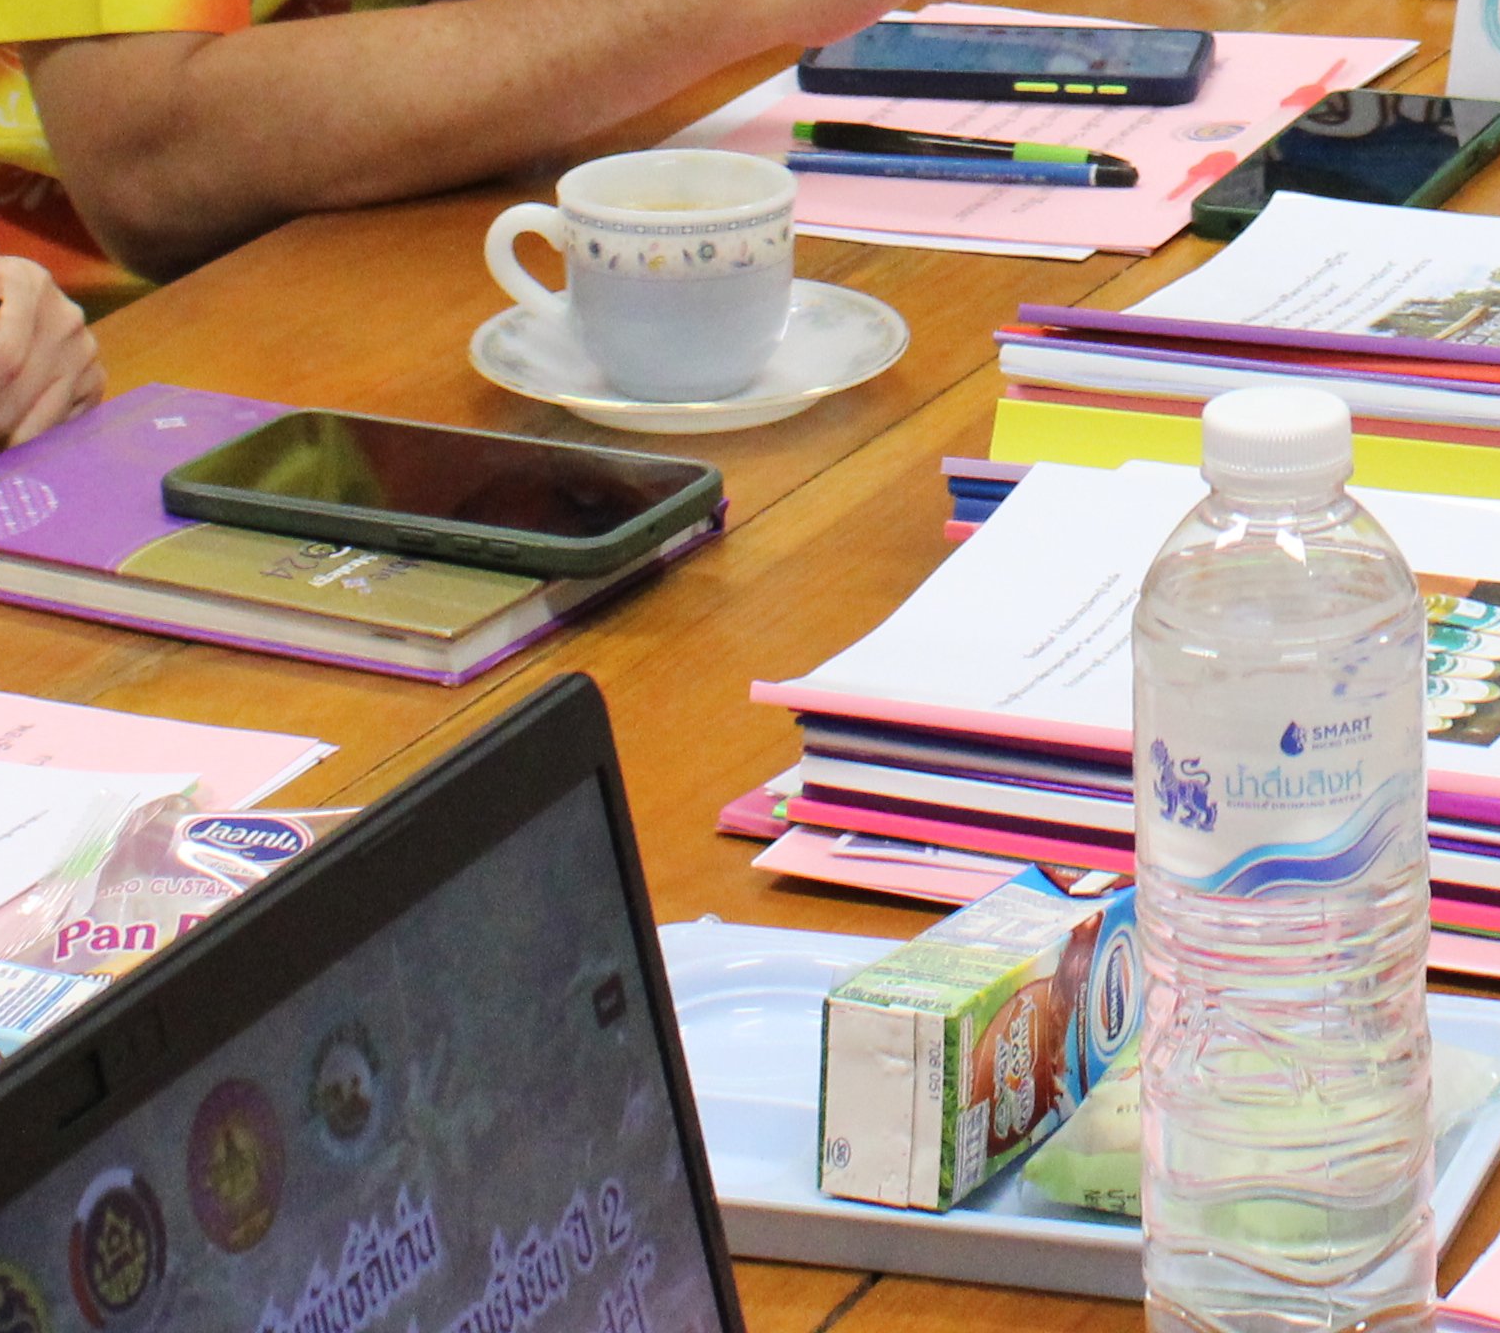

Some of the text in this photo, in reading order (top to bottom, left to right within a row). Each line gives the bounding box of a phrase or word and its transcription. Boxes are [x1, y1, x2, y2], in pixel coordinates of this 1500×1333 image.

[1312, 715, 1372, 741] SMART
[1225, 760, 1365, 799] น้ำดื่มสิงห์
[150, 876, 246, 899] CUSTAR
[54, 918, 158, 962] Pan
[929, 1038, 942, 1103] 708 051
[601, 1185, 627, 1245] 2
